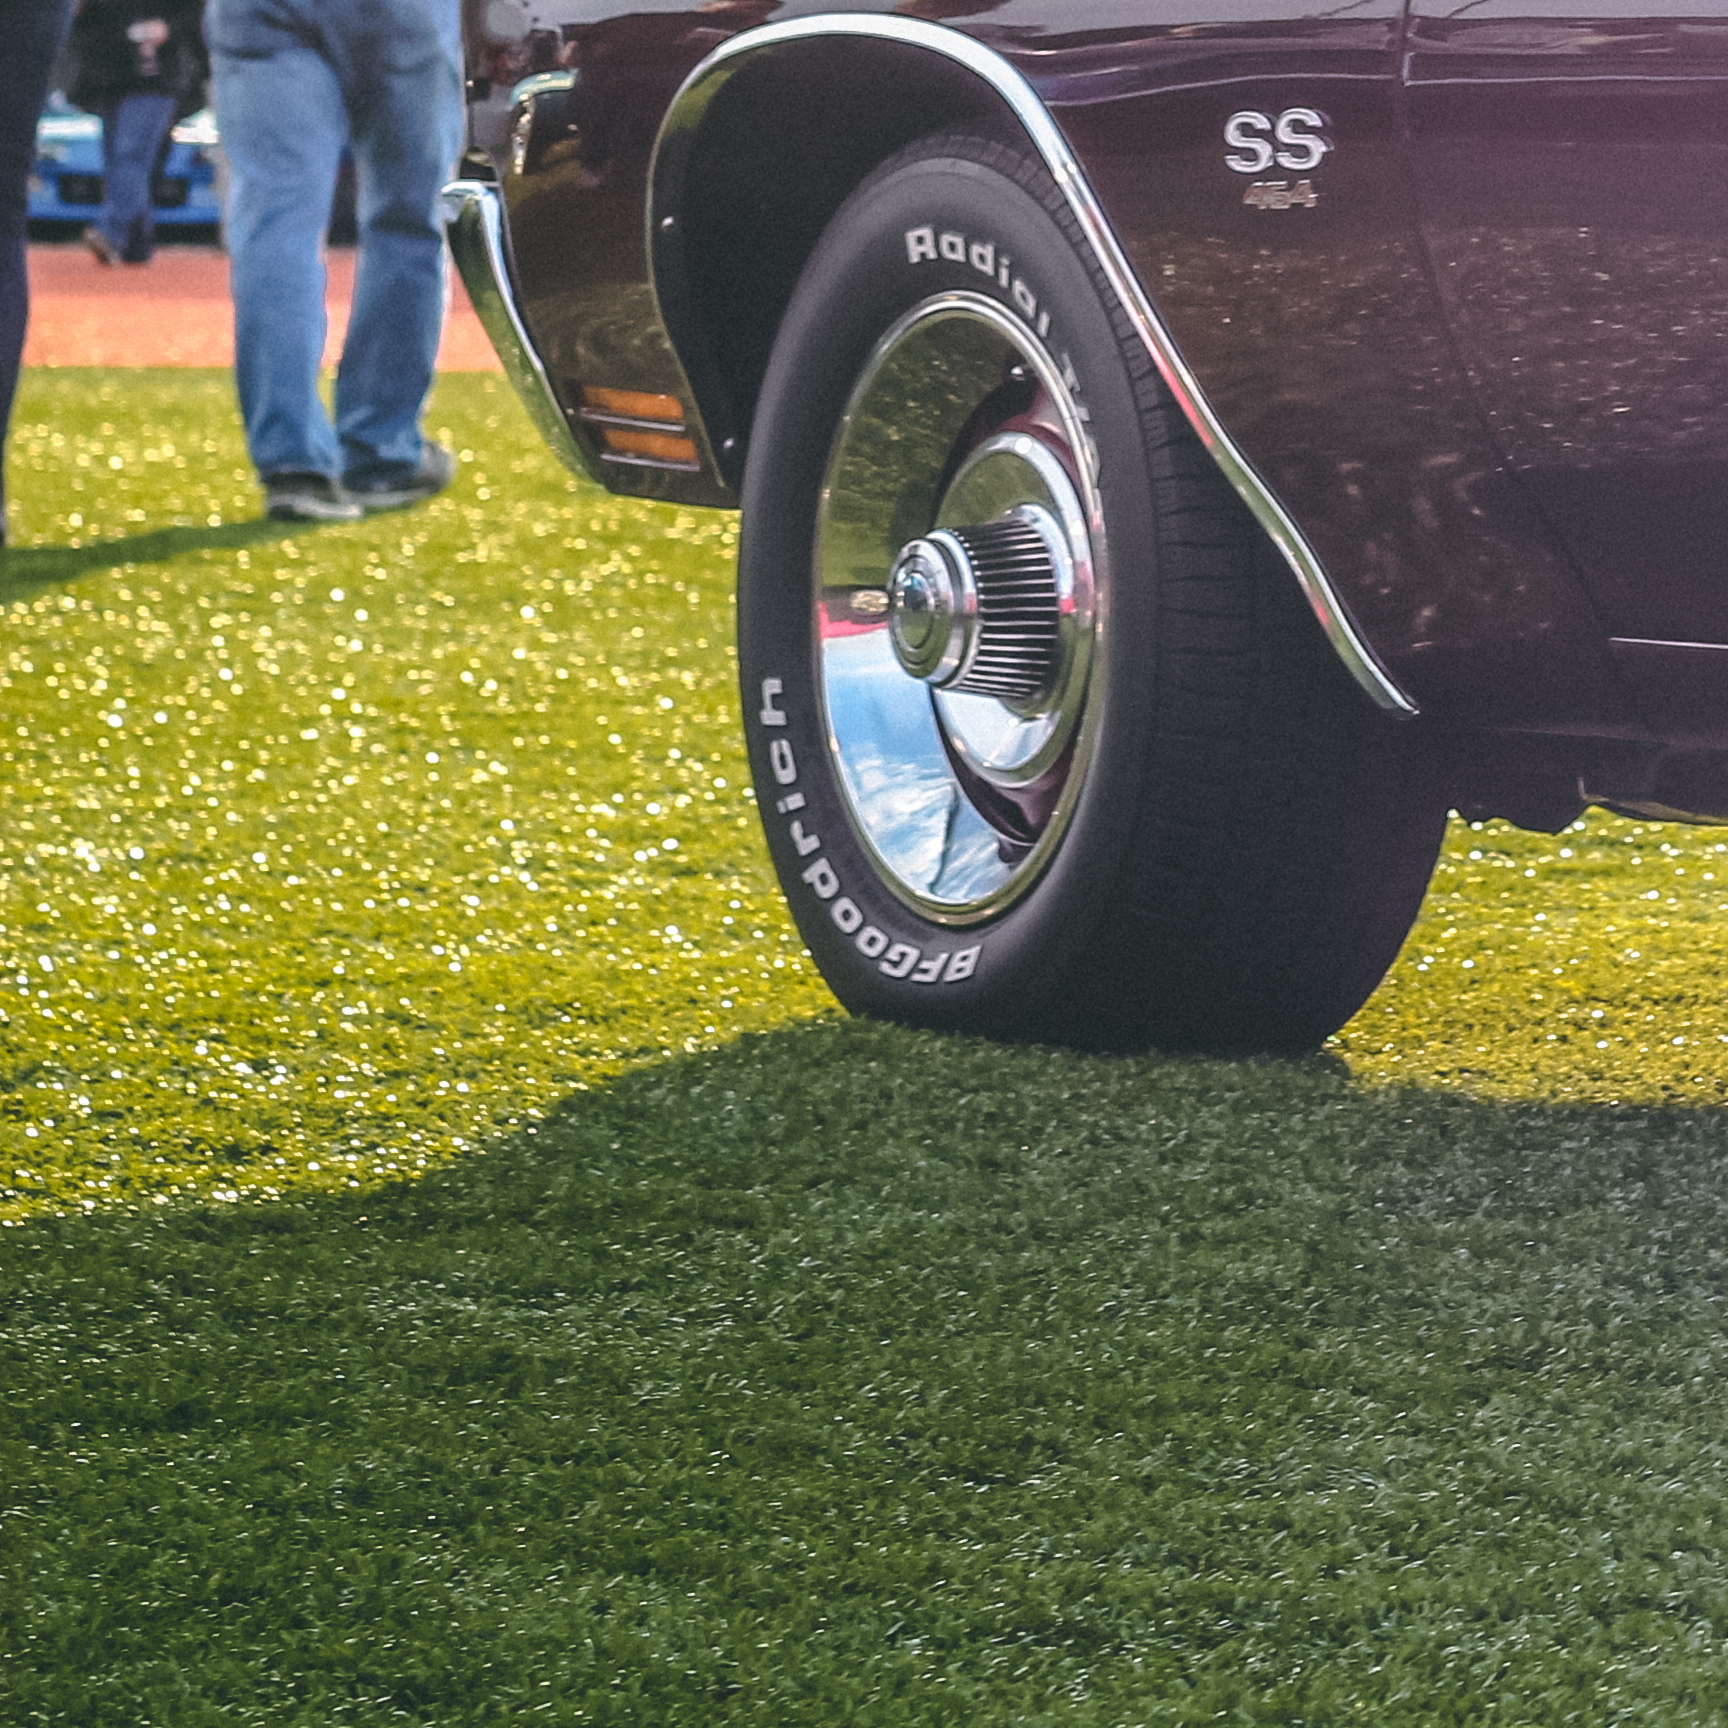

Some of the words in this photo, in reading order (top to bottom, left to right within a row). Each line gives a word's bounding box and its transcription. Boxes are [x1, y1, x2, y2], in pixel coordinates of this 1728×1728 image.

[1223, 107, 1332, 172] SS
[1243, 179, 1319, 210] 454
[905, 225, 1050, 338] Radial
[760, 677, 983, 984] BFGoodrich
